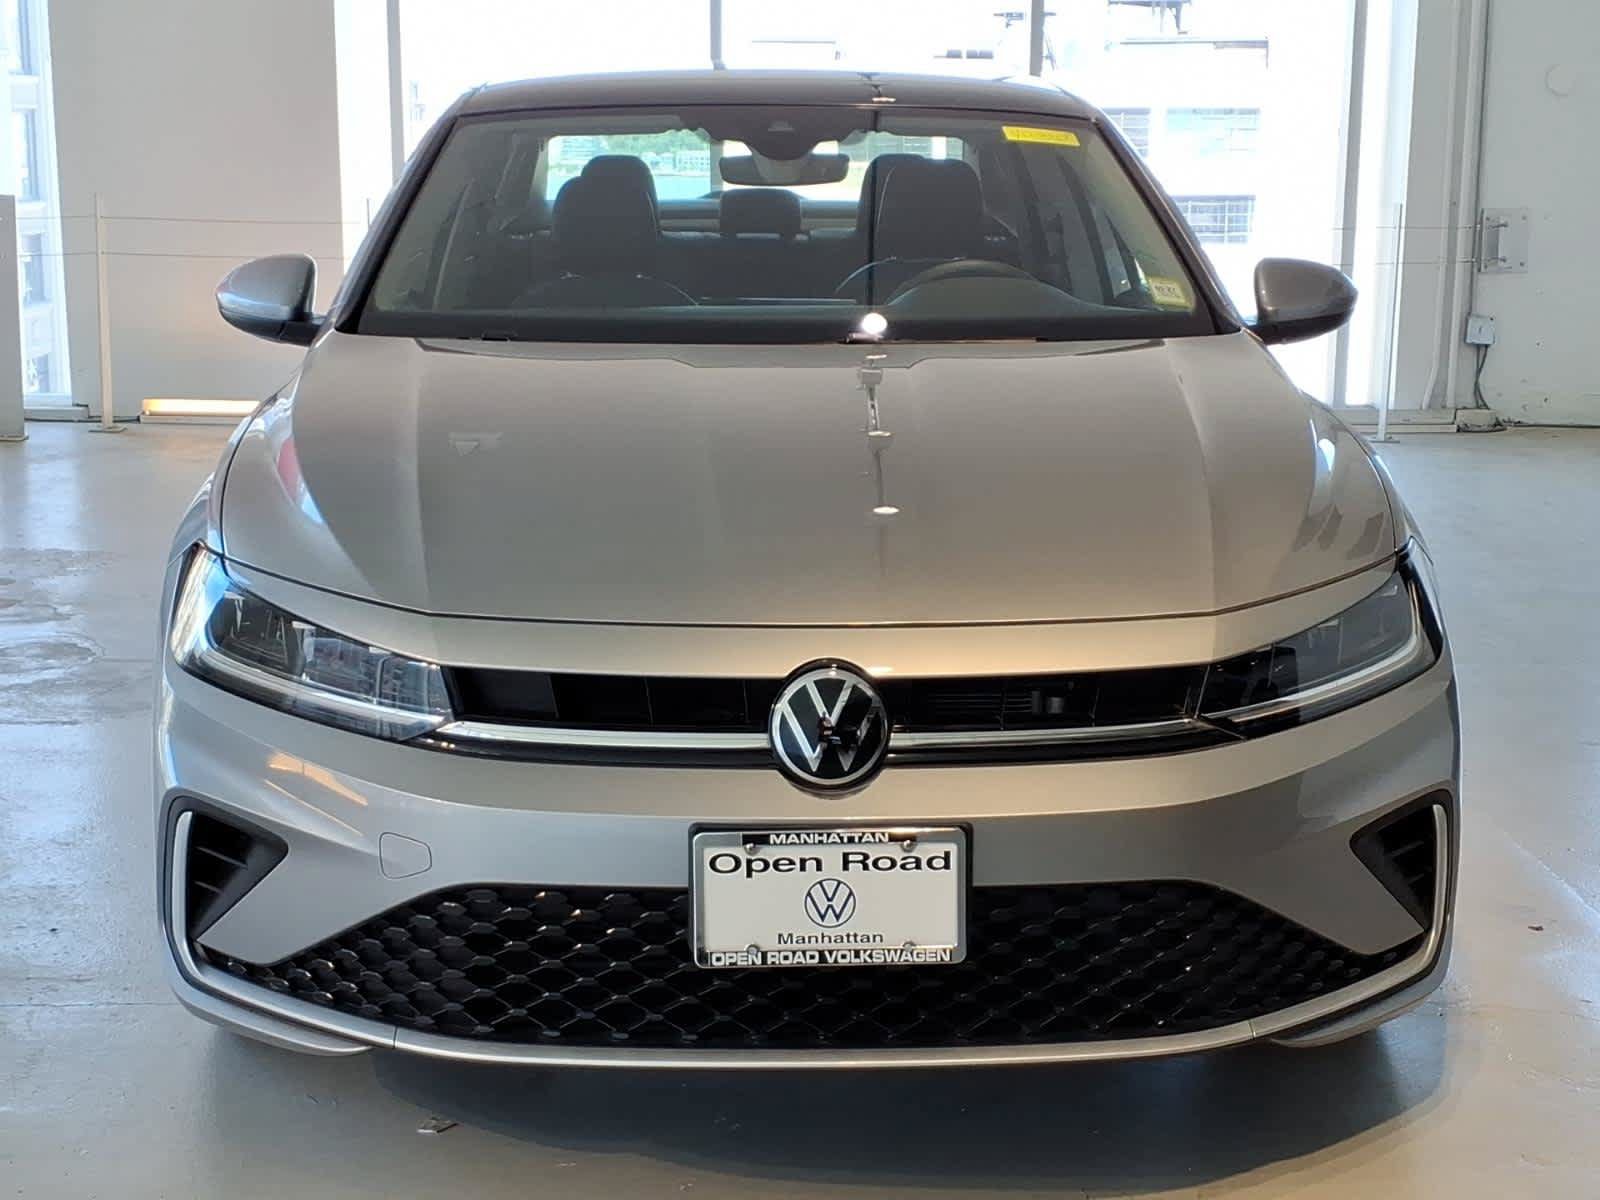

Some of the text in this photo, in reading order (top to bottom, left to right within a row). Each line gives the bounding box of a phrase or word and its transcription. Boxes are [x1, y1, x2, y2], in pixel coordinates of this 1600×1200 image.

[769, 832, 889, 845] MANHATTAN
[709, 851, 952, 877] Open Road
[804, 879, 856, 927] VW
[777, 933, 883, 945] Manhattan
[711, 951, 951, 966] OPEN ROAD VOLKSWAGEN
